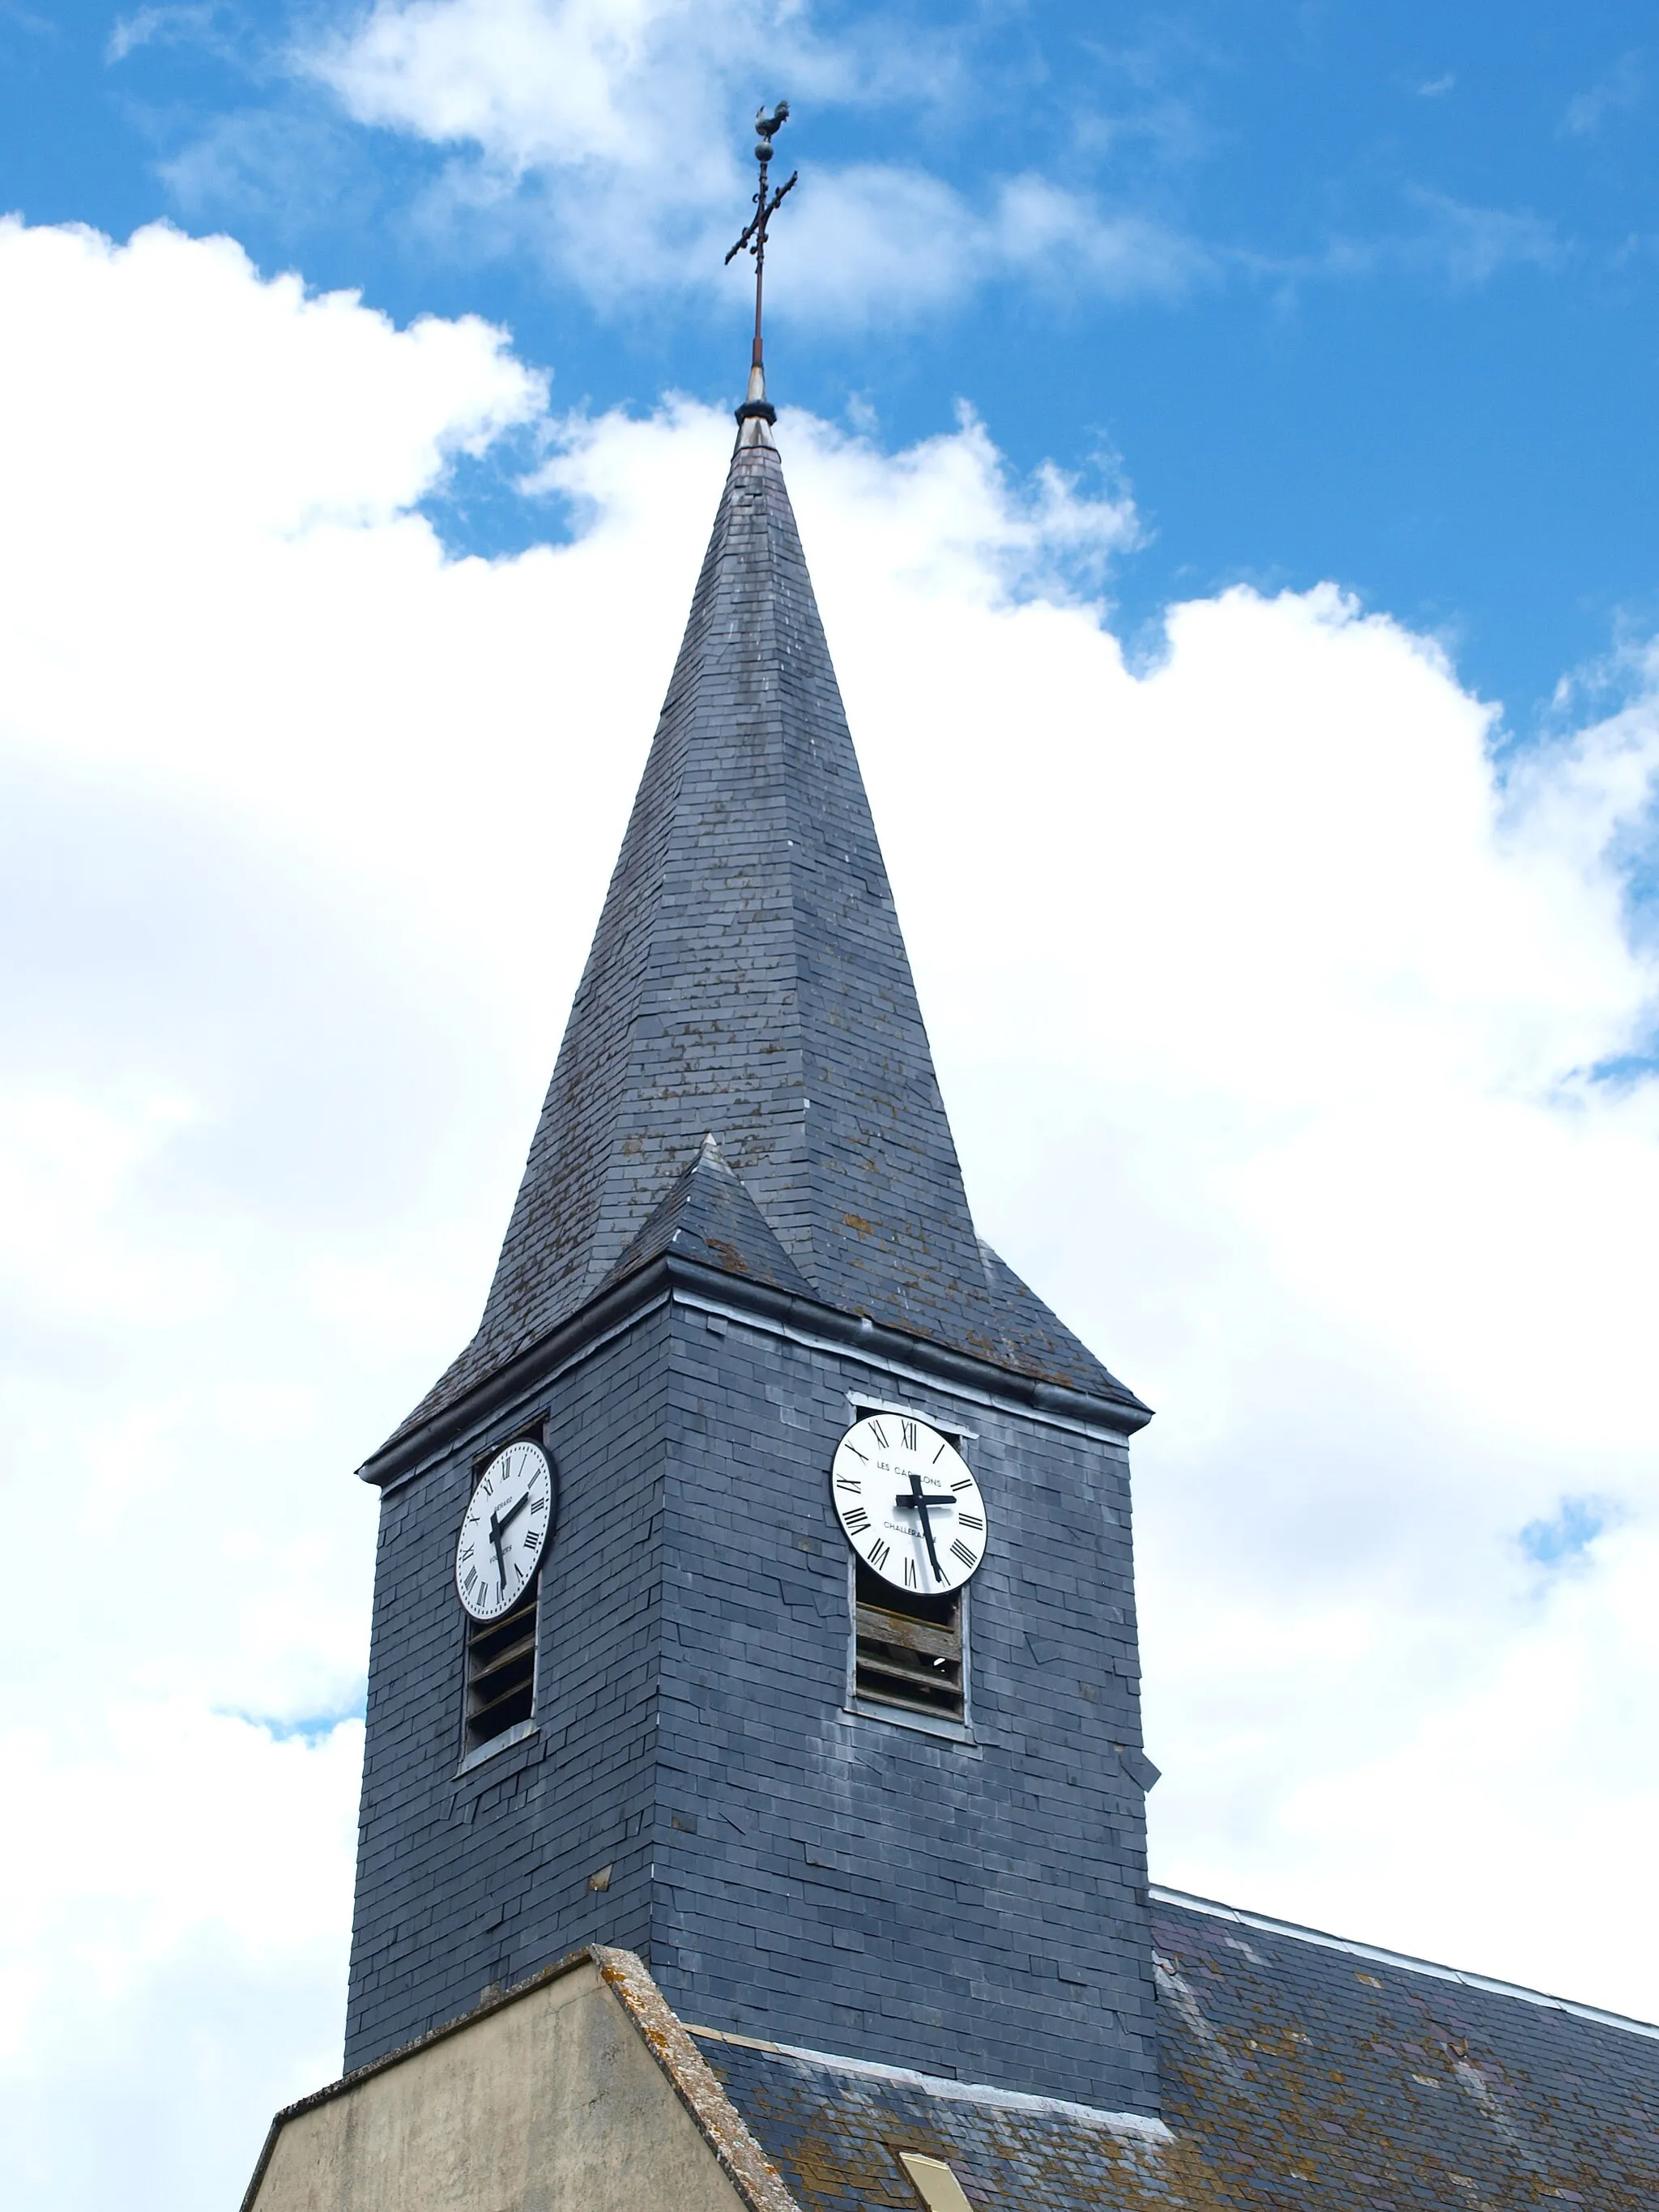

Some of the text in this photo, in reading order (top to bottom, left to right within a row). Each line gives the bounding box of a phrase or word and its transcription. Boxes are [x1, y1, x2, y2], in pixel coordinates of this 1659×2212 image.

[868, 1420, 889, 1450] XI
[901, 1419, 916, 1451] XII
[845, 1439, 868, 1465] X
[877, 1461, 889, 1471] LES
[836, 1474, 861, 1494] IX
[842, 1507, 871, 1536] VIII
[958, 1513, 983, 1530] III
[868, 1538, 890, 1571] VII
[949, 1538, 978, 1569] IIII
[905, 1557, 917, 1588] VI
